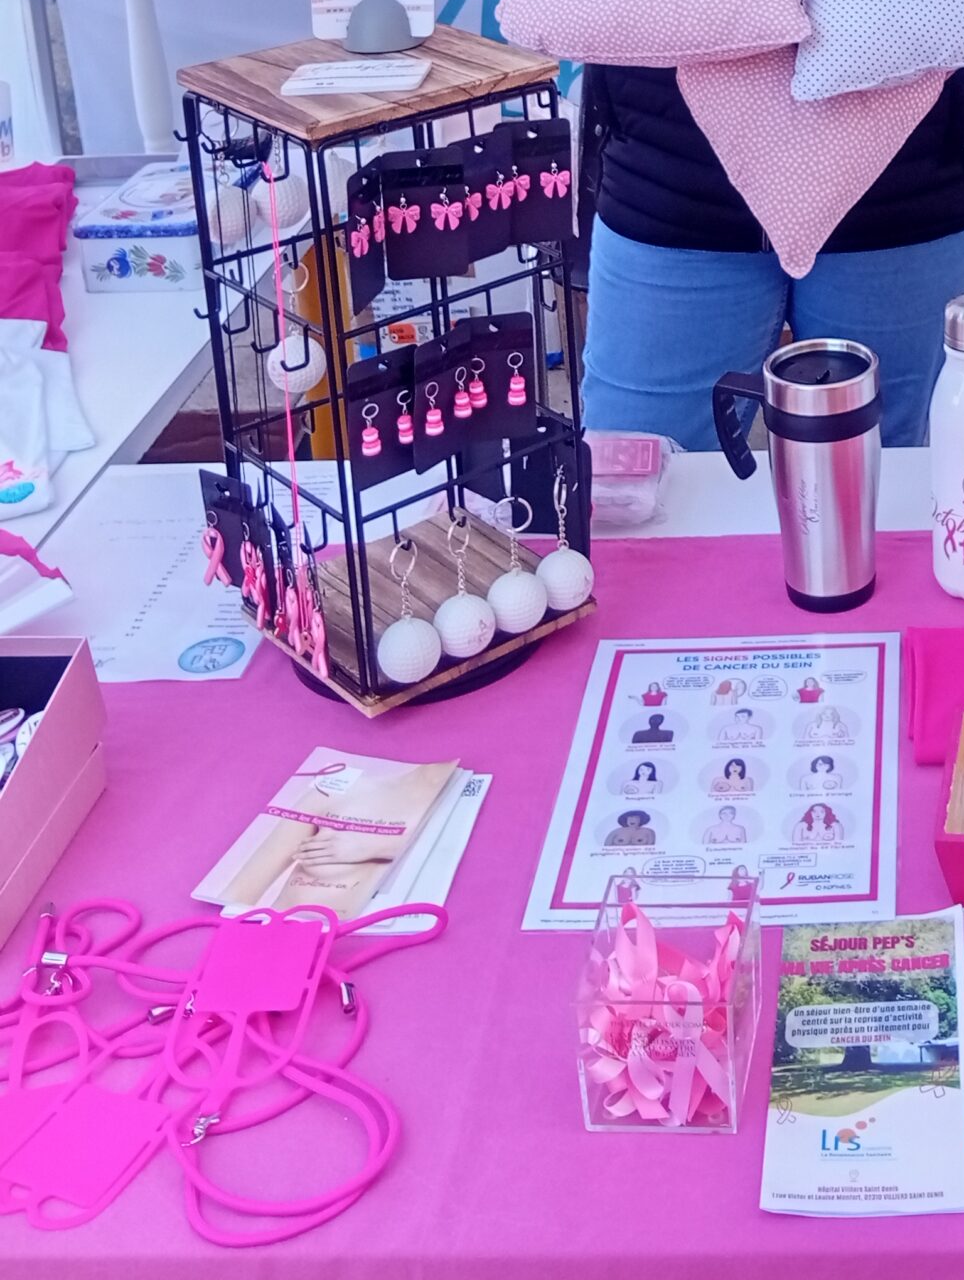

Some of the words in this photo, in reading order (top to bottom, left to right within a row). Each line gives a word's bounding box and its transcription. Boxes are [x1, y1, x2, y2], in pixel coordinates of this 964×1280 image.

[752, 652, 822, 661] POSSIBLES
[783, 661, 813, 669] SEIN
[281, 810, 298, 819] que
[298, 814, 310, 822] les
[810, 935, 868, 952] SÉJOUR
[872, 934, 915, 950] PEP'S
[891, 953, 949, 971] CANCER
[794, 1008, 804, 1017] Un
[806, 1007, 831, 1017] séjour
[872, 1005, 895, 1014] d'une
[897, 1004, 931, 1012] semaine
[801, 1017, 828, 1026] centré
[830, 1017, 842, 1025] sur
[854, 1015, 882, 1025] reprise
[885, 1013, 923, 1022] d'activité
[791, 1026, 828, 1037] physique
[830, 1024, 853, 1034] après
[854, 1025, 865, 1033] un
[867, 1023, 910, 1032] traitement
[912, 1023, 930, 1031] pour
[830, 1035, 861, 1044] CANCER
[862, 1035, 872, 1043] DU
[874, 1034, 892, 1043] SEIN
